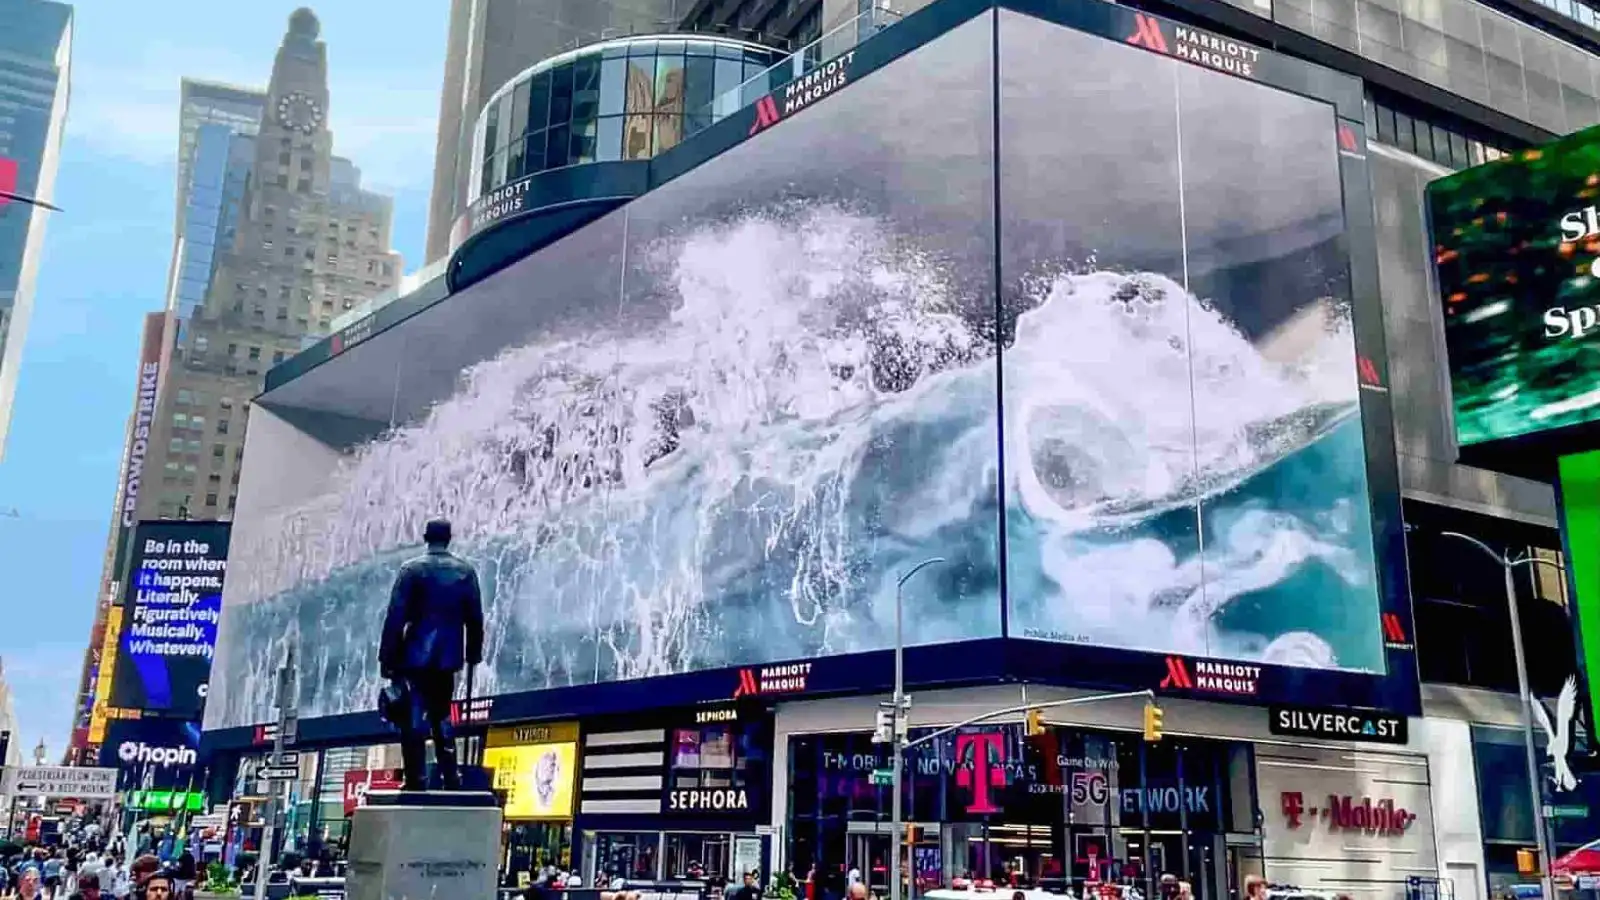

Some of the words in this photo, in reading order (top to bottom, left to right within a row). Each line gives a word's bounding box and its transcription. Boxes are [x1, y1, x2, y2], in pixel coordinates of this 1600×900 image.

[1175, 26, 1260, 63] MARRIOTT
[1176, 44, 1252, 76] MARQUIS
[786, 51, 855, 98] MARRIOTT
[785, 72, 846, 113] MARQUIS
[1543, 303, 1600, 340] Sp
[123, 361, 159, 528] CROWDSTRIKE
[144, 540, 165, 554] Be
[166, 540, 181, 554] in
[184, 539, 209, 554] the
[142, 558, 183, 570] room
[139, 572, 152, 586] it
[153, 572, 222, 590] happens.
[136, 590, 200, 606] Literally.
[134, 605, 219, 625] Figuratively
[131, 623, 205, 641] Musically.
[761, 663, 812, 678] MARRIOTT
[1196, 661, 1261, 679] MARRIOTT
[761, 676, 806, 691] MARQUIS
[1197, 676, 1255, 693] MARQUIS
[696, 710, 737, 723] SEPHORA
[1279, 709, 1399, 737] SILVERCAST
[138, 743, 197, 768] hopin
[1057, 755, 1083, 768] Game
[1071, 772, 1109, 806] 5G
[669, 790, 748, 809] SEPHORA
[1117, 786, 1210, 813] ETWORK
